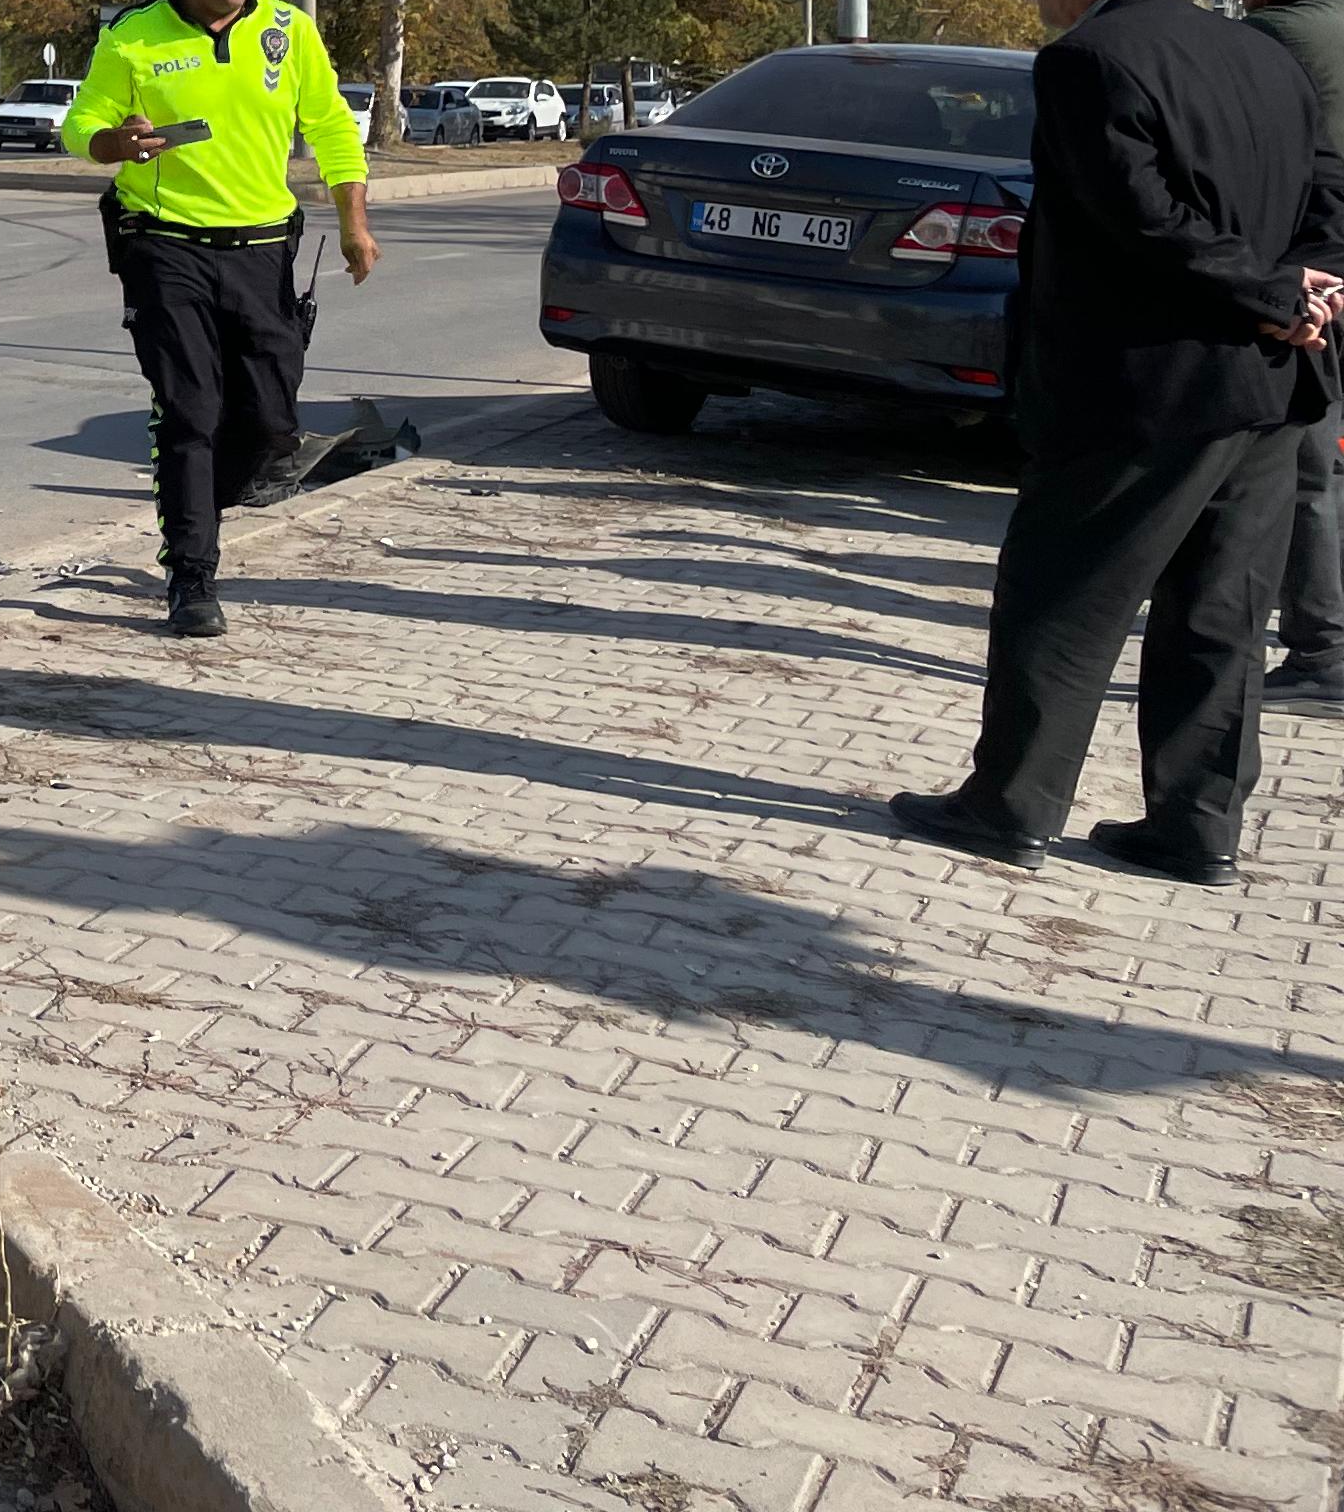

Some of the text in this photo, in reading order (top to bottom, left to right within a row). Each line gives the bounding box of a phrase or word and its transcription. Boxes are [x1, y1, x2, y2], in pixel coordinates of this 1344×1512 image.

[897, 177, 961, 191] COROLLA
[704, 206, 847, 246] 48 NG 403
